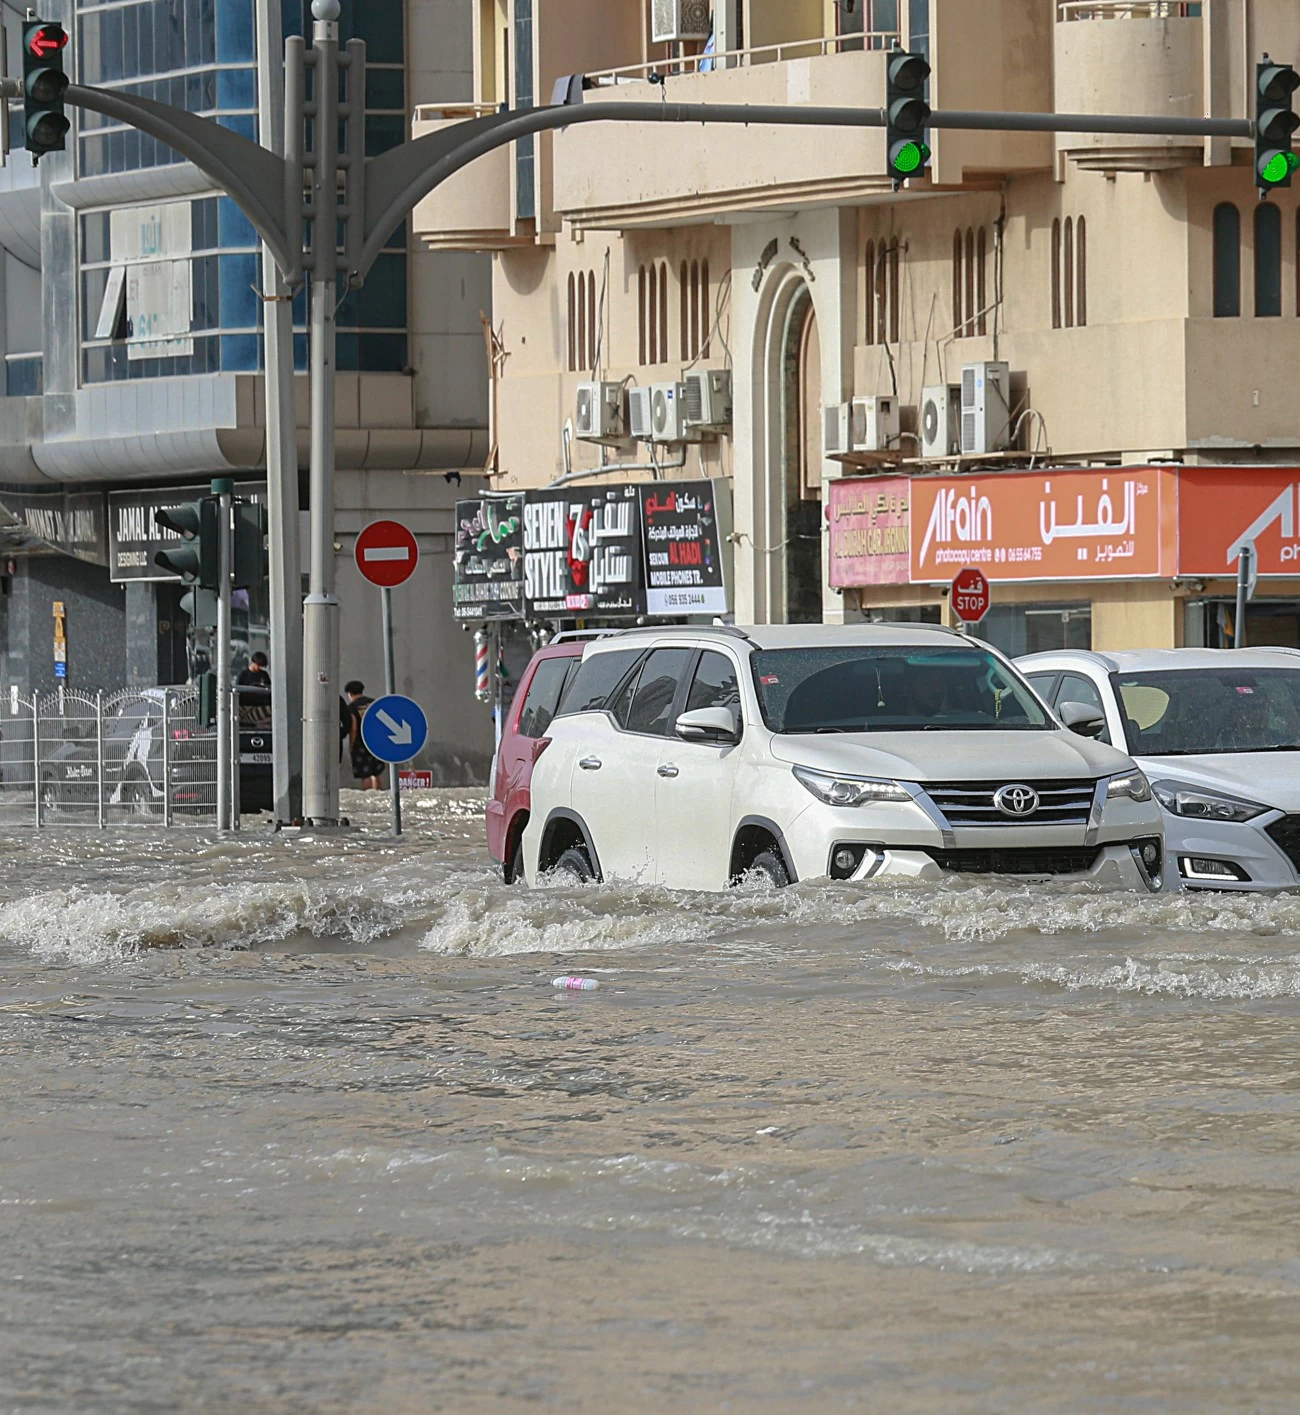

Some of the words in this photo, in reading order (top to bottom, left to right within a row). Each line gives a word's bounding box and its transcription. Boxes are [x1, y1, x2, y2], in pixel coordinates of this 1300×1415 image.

[117, 506, 147, 541] JAMAL
[149, 506, 161, 540] AL
[524, 501, 565, 550] SEVEN
[588, 492, 632, 546] سفن
[919, 486, 992, 569] Alfain
[1040, 478, 1135, 560] الفين
[670, 542, 680, 564] AL
[680, 541, 702, 565] HADI
[935, 547, 970, 565] photocopy
[971, 546, 992, 562] centre
[1095, 540, 1134, 562] للتصوير
[524, 551, 565, 599] STYLE
[588, 545, 631, 595] ستايل
[650, 571, 670, 586] MOBILE
[671, 570, 692, 585] PHONES
[957, 576, 984, 594] قف
[957, 596, 985, 610] STOP
